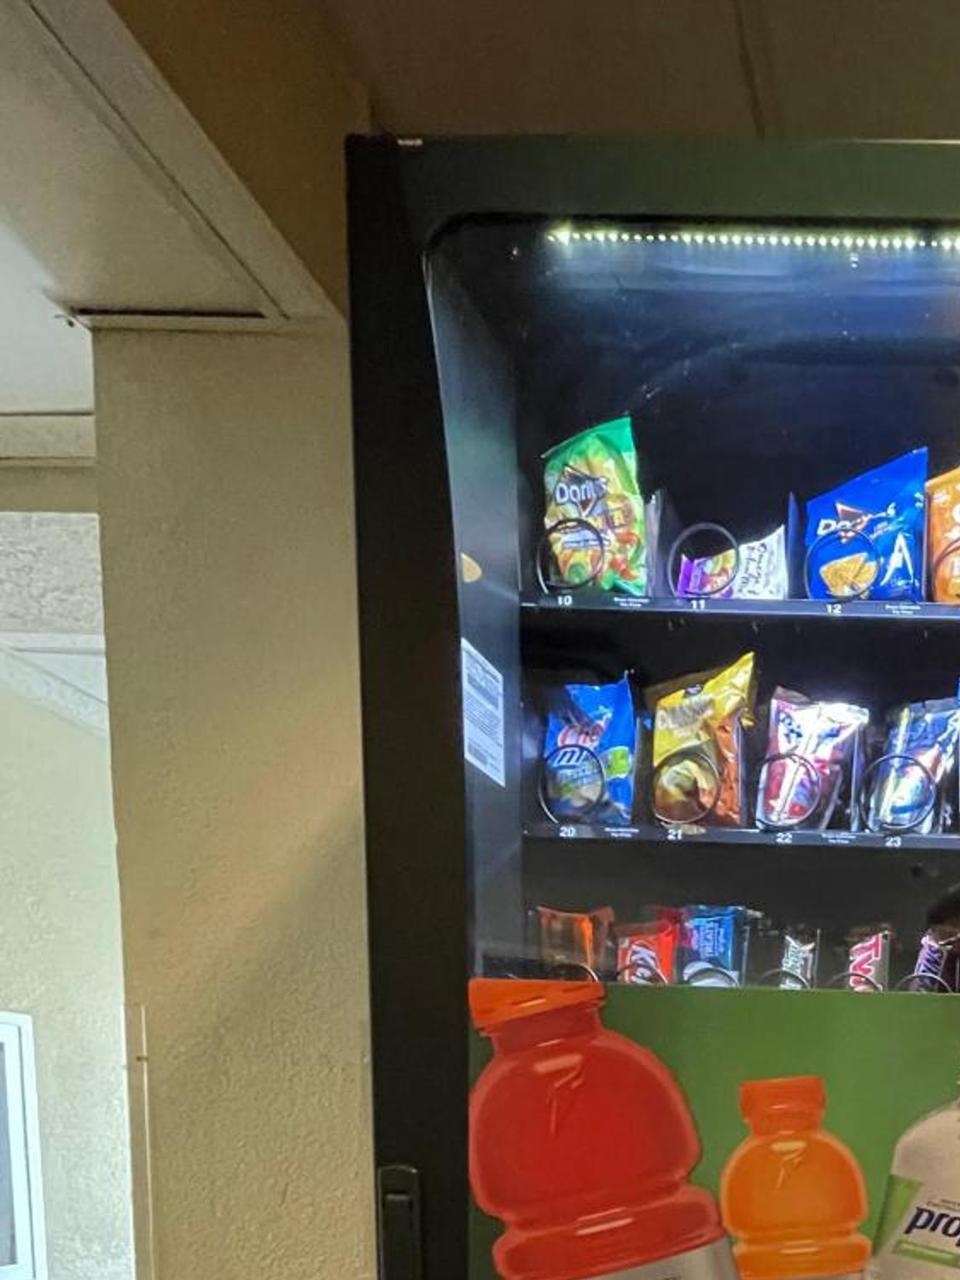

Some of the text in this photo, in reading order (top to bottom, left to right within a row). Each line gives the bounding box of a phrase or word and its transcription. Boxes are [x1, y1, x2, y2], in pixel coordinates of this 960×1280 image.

[557, 596, 572, 606] 10
[691, 600, 705, 609] 11
[826, 604, 842, 613] 12
[559, 826, 576, 837] 20
[667, 829, 683, 840] 21
[776, 833, 792, 843] 22
[885, 836, 901, 847] 23
